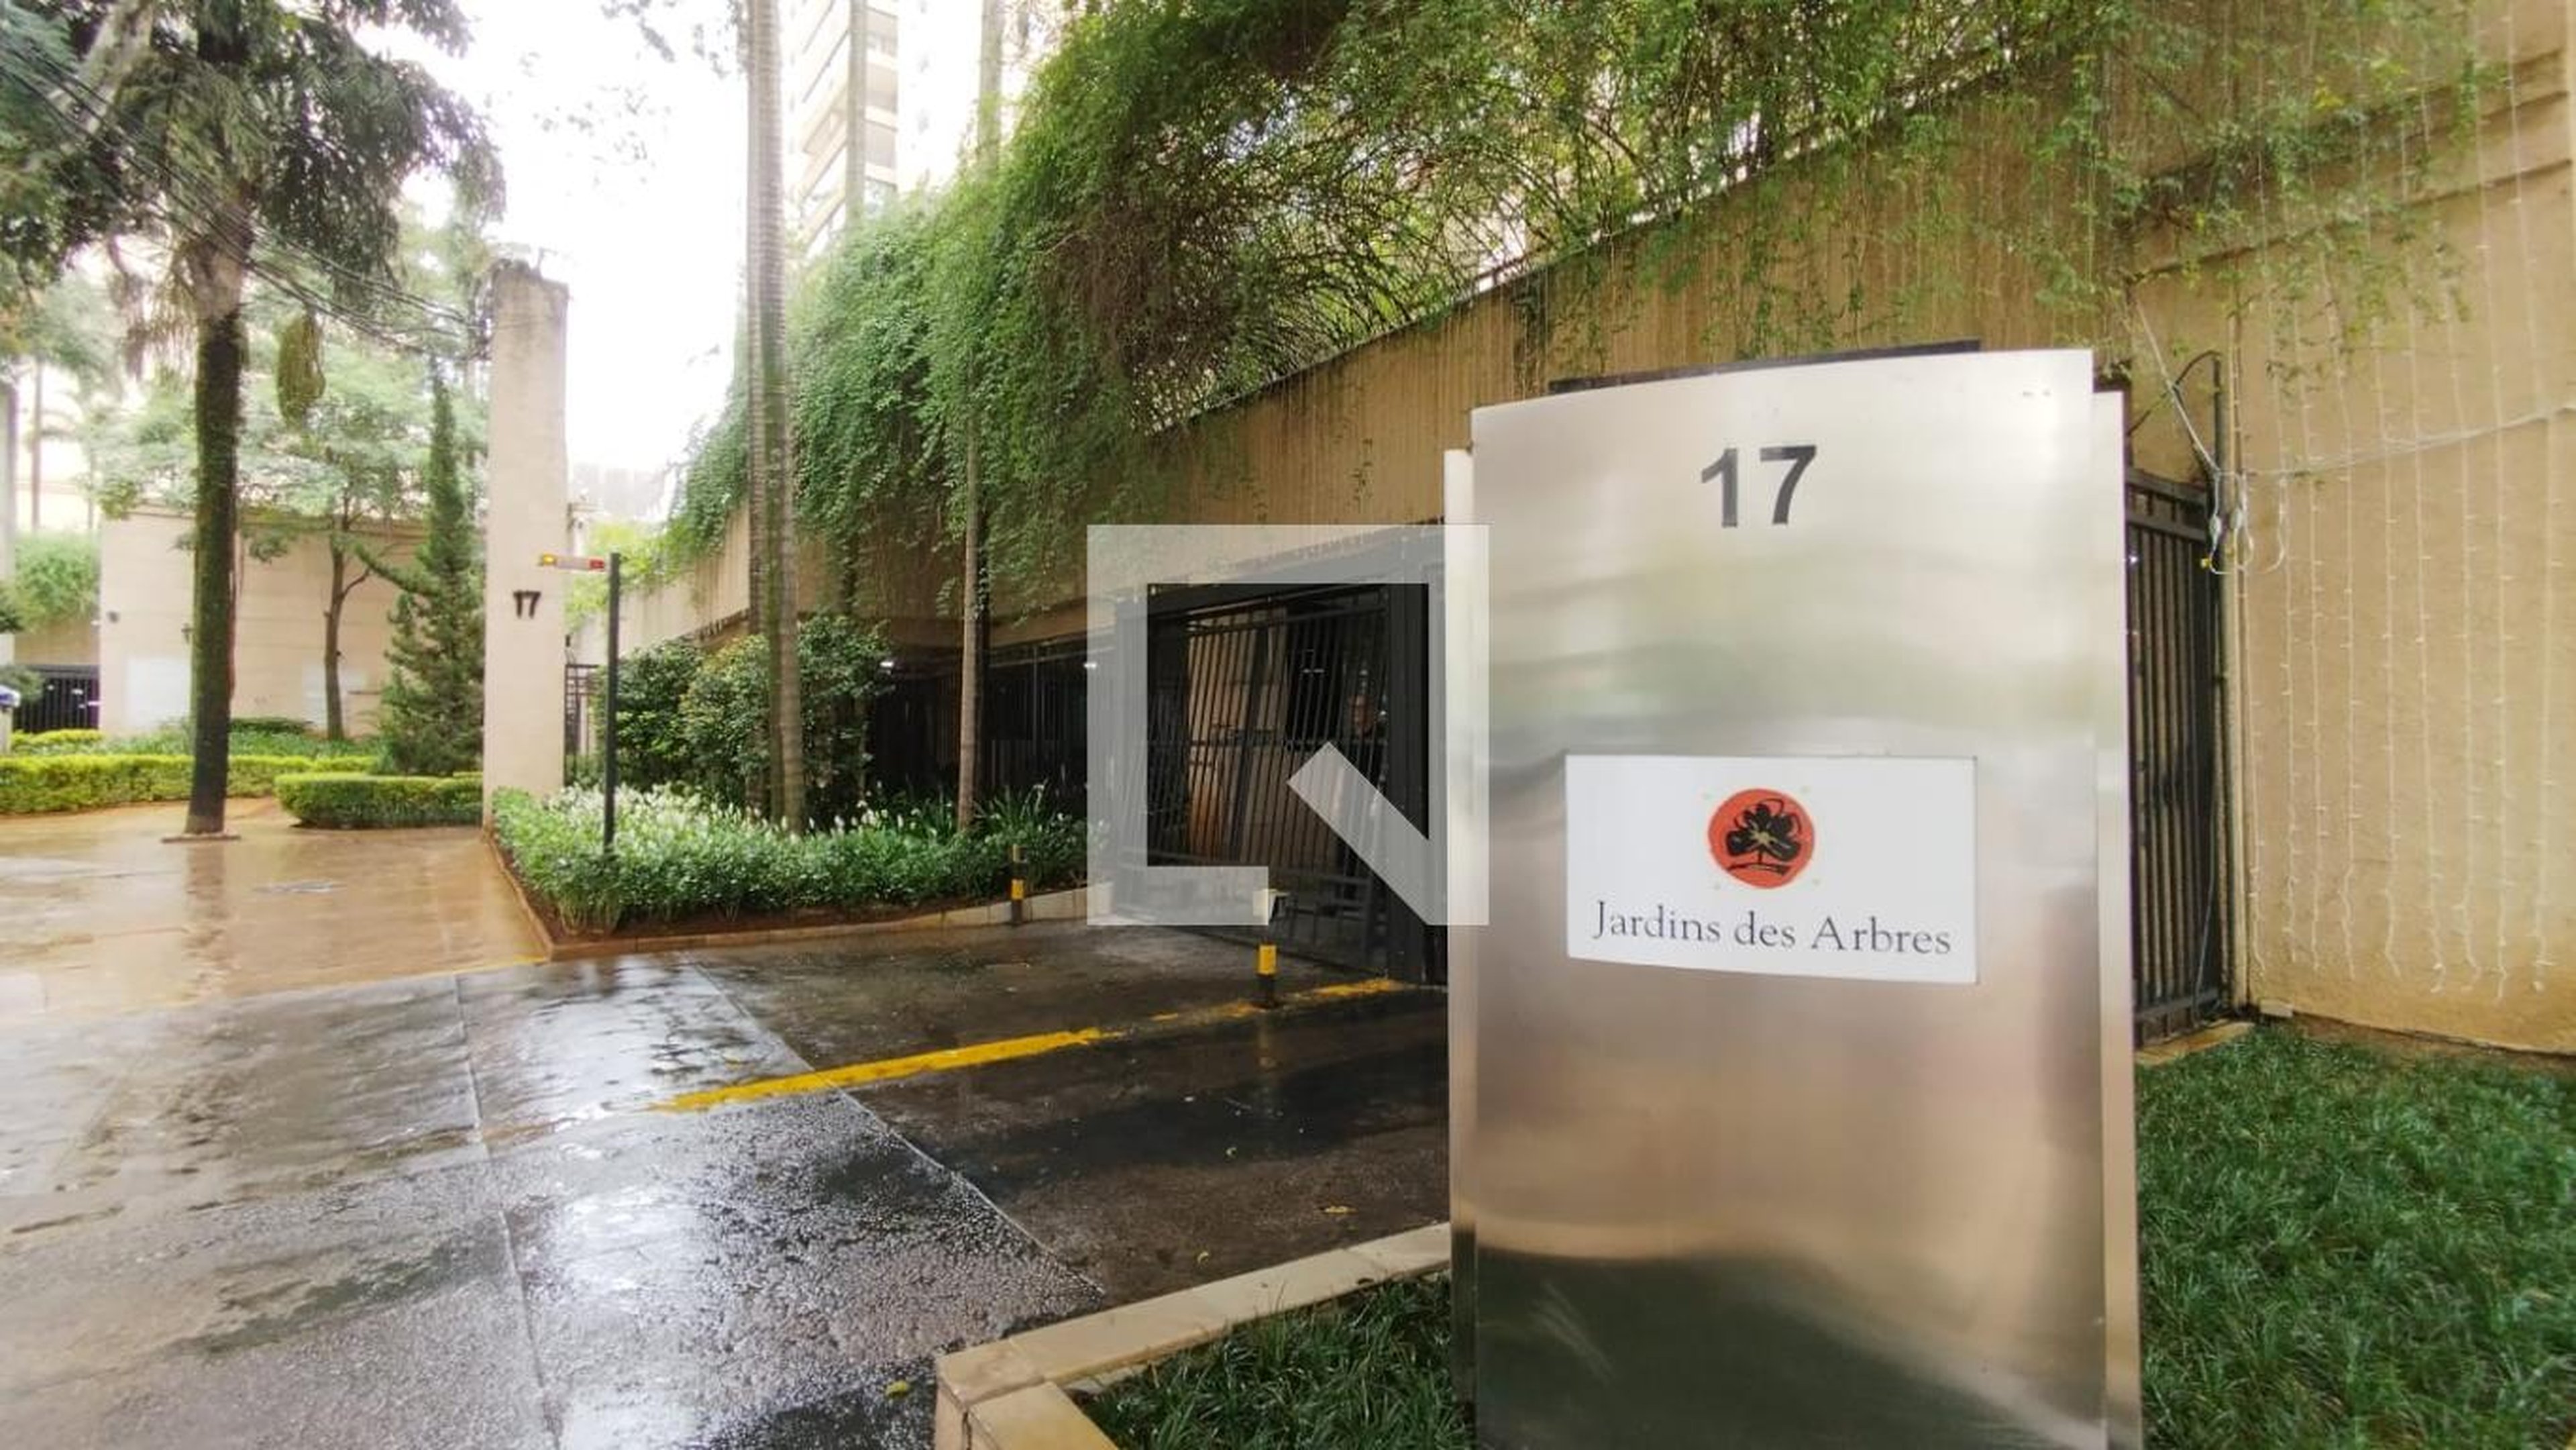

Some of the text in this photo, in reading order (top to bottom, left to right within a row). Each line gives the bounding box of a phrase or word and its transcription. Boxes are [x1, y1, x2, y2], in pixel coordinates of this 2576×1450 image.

[1701, 444, 1817, 528] 17
[513, 590, 541, 619] 17
[1593, 900, 1951, 955] Jardins des Arbres
